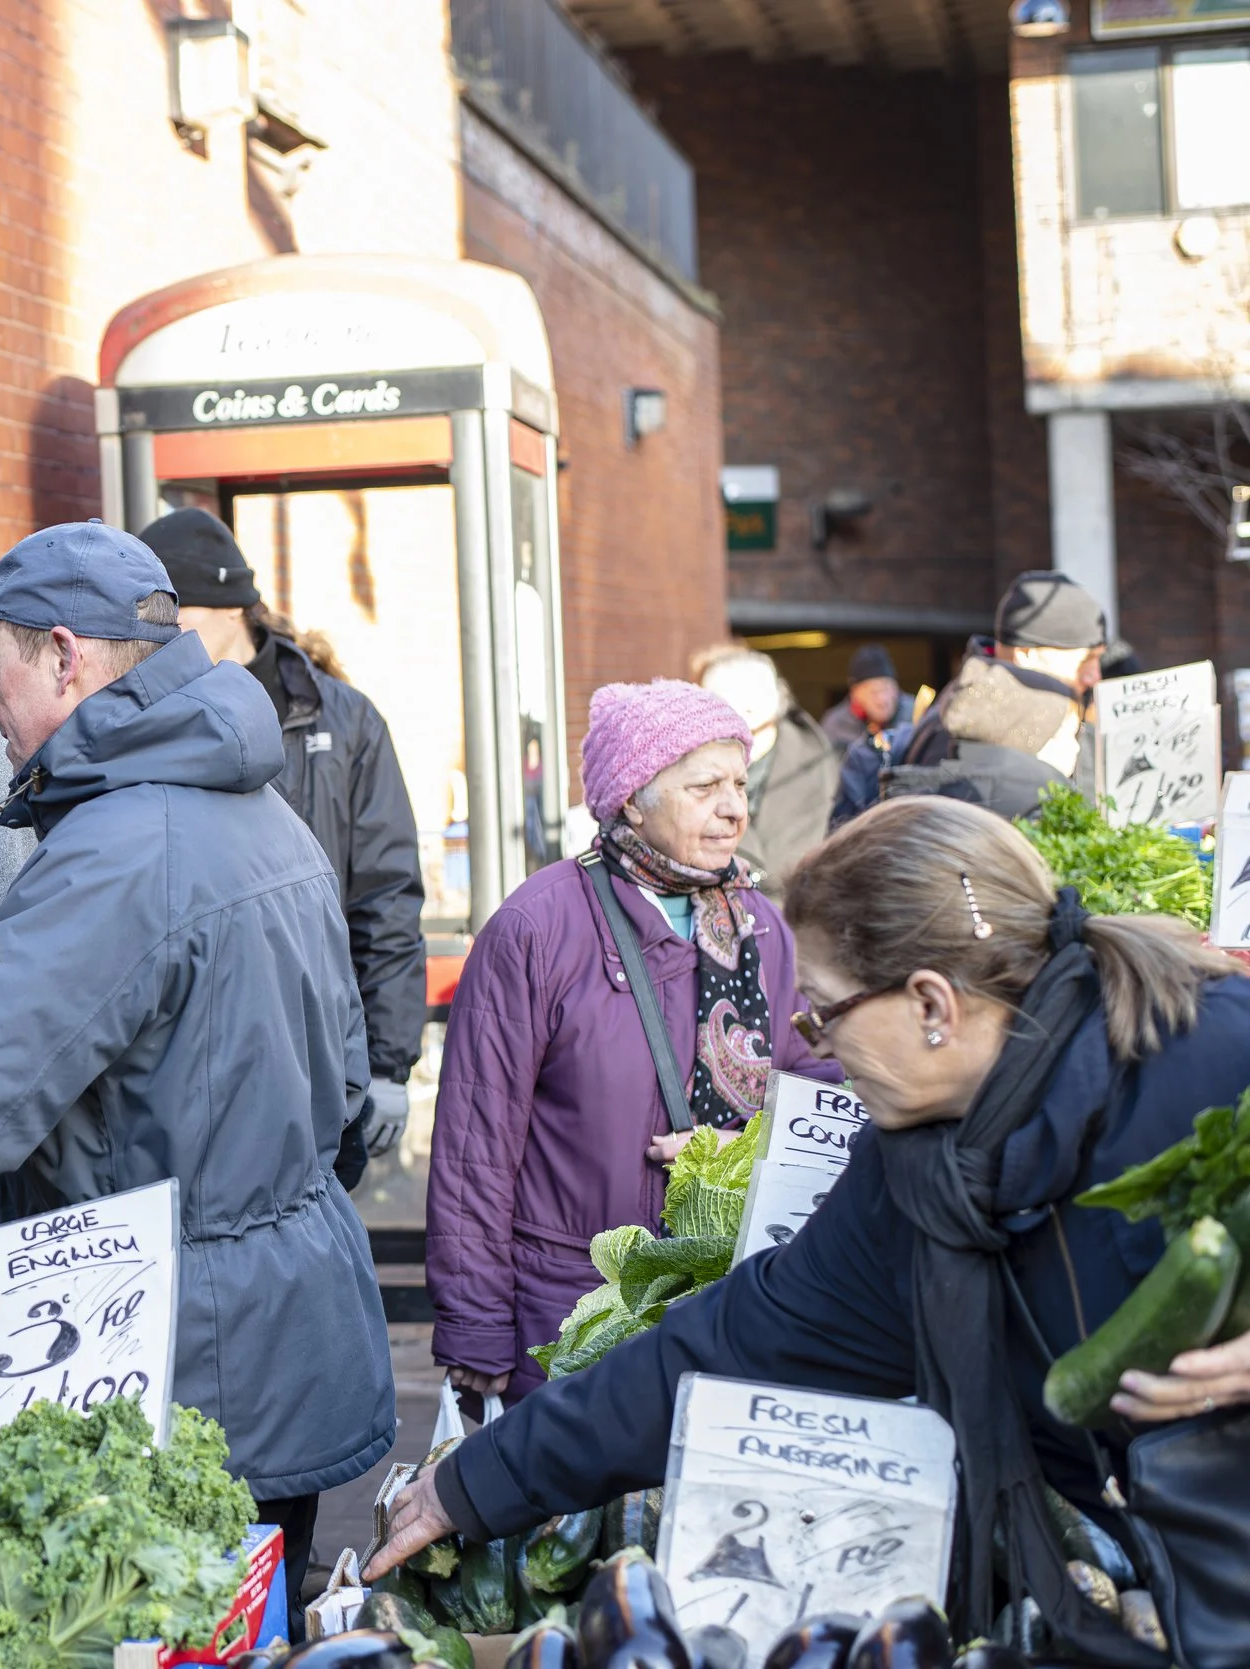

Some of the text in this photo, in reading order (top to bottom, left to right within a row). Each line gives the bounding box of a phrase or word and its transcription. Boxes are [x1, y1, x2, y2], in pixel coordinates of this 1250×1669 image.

[192, 379, 401, 423] Coins & Cards
[21, 1209, 99, 1242] LARGE
[8, 1235, 139, 1279] ENGLISH
[749, 1394, 872, 1441] FRESH
[738, 1435, 920, 1486] AUBERGINES
[684, 1500, 788, 1591] 2
